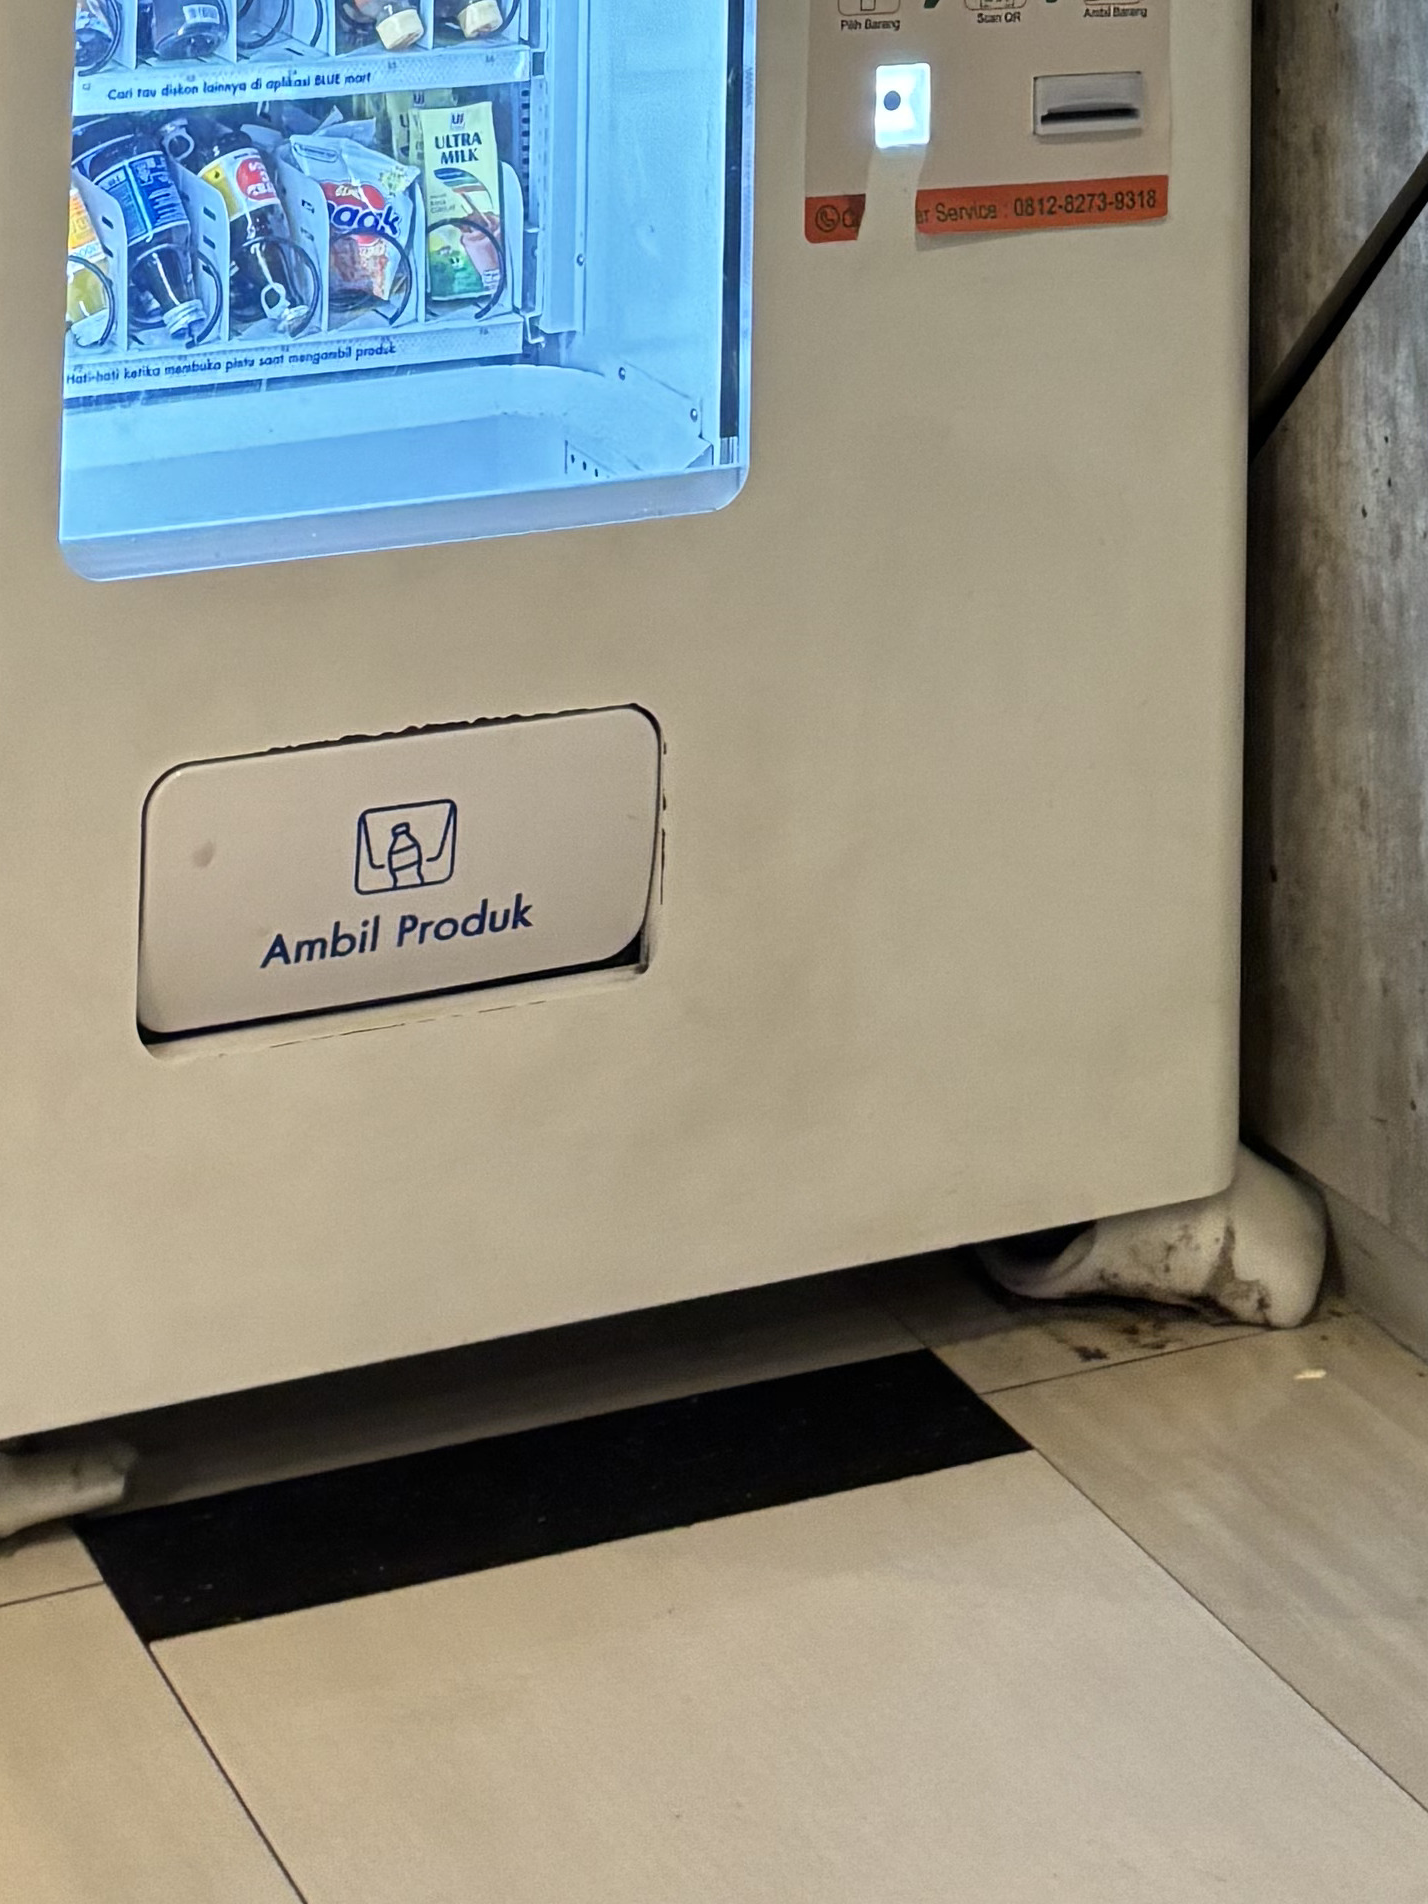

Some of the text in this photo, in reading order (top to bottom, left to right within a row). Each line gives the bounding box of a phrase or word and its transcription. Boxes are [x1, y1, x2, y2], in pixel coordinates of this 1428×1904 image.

[976, 10, 1021, 24] Scan QR
[1083, 5, 1148, 19] Ambil Barang
[840, 17, 901, 32] Pilih Barang
[161, 82, 198, 98] diskon
[202, 80, 247, 96] lainnya
[251, 78, 262, 91] di
[314, 72, 340, 87] BLUE
[344, 70, 371, 84] mart
[434, 131, 483, 150] ULTRA
[440, 148, 479, 165] MILK
[935, 202, 997, 222] Service
[1013, 189, 1157, 217] 0812-8273-9318
[66, 370, 120, 385] Hati-hati
[123, 365, 161, 380] ketika
[259, 353, 284, 366] saat
[260, 892, 535, 969] Ambil Produk
